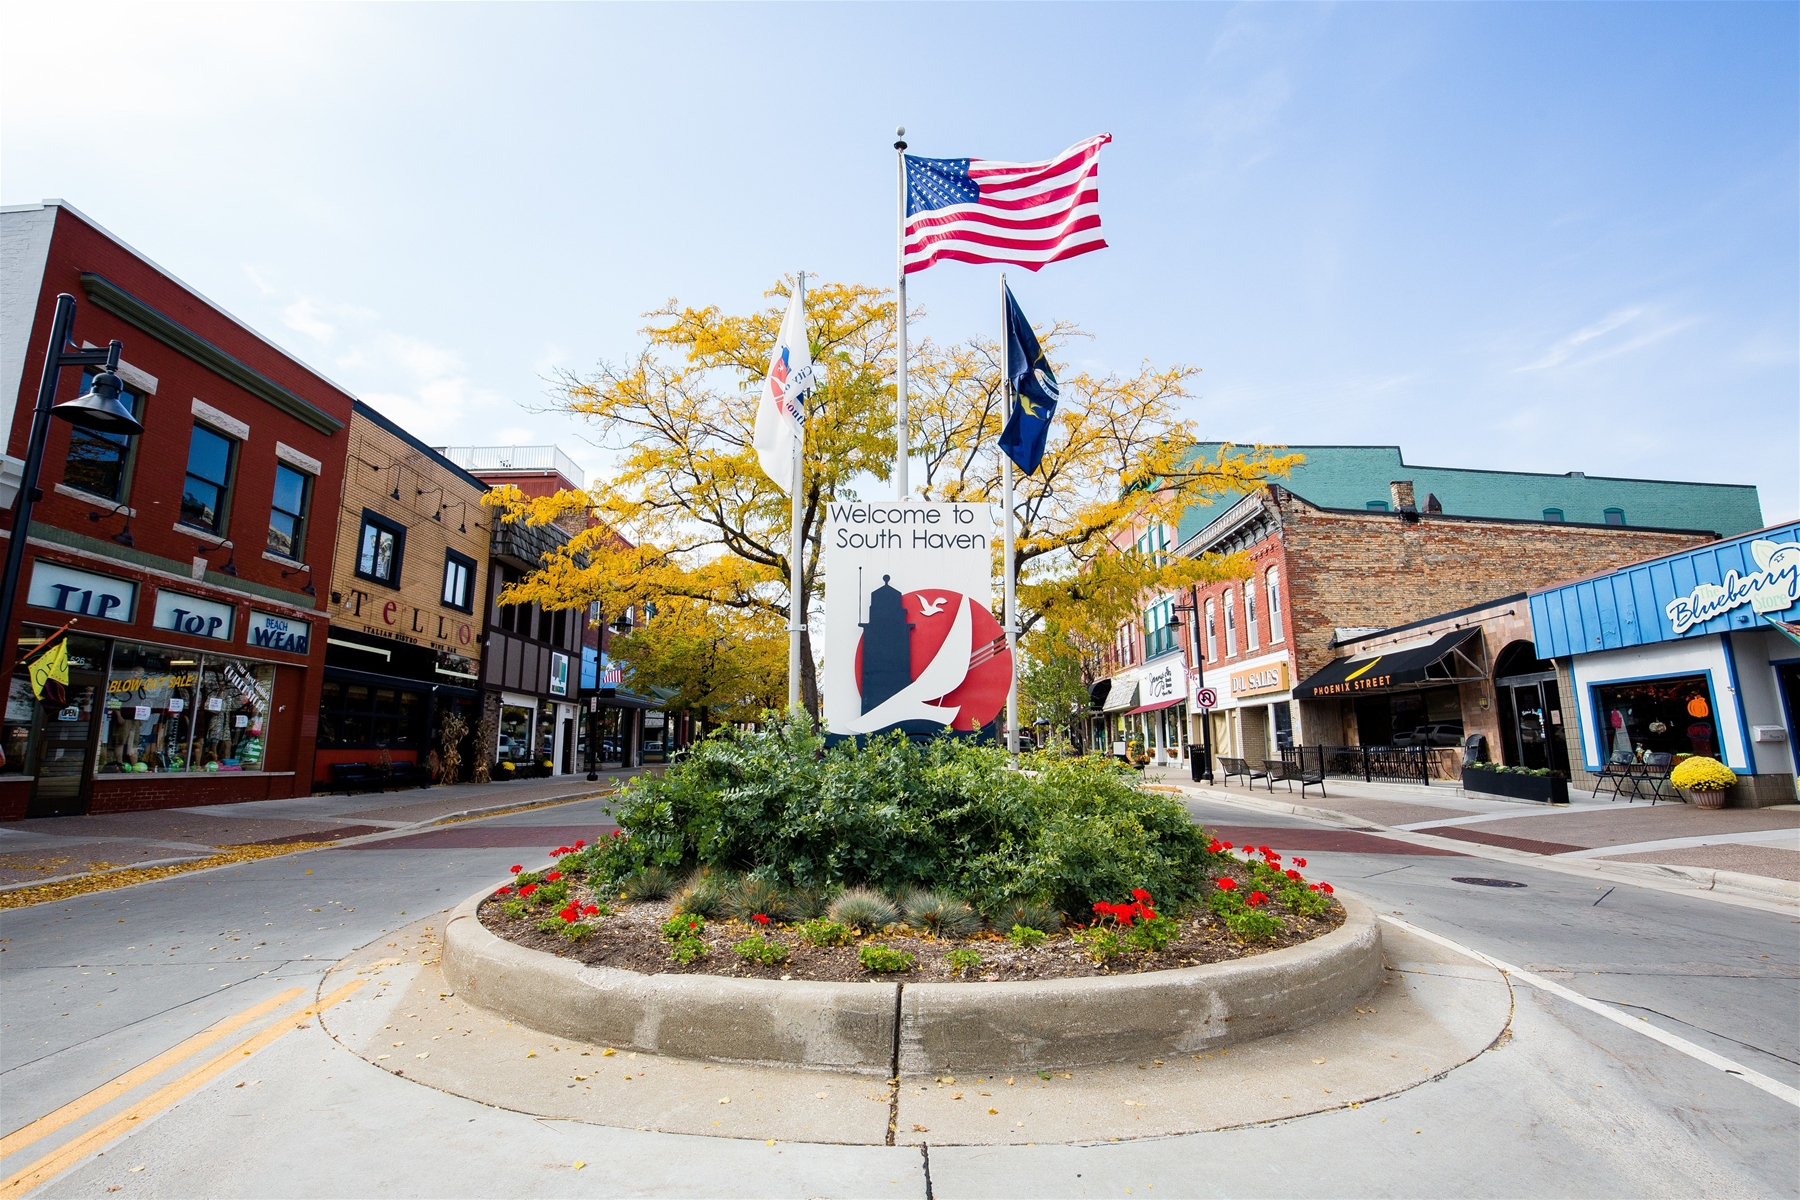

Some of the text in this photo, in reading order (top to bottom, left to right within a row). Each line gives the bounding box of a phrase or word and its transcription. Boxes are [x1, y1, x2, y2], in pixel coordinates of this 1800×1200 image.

[830, 504, 974, 524] Welcome to
[836, 528, 985, 549] South Haven
[1670, 564, 1800, 628] Blueberry
[1699, 585, 1720, 600] The
[1753, 593, 1789, 611] Store
[51, 583, 223, 638] TIP TOP
[265, 617, 289, 632] BEACH
[254, 626, 307, 653] WEAR
[363, 626, 393, 640] ITALIAN
[395, 633, 418, 645] BISTRO
[69, 656, 86, 666] 526
[108, 679, 143, 693] BLOW
[143, 676, 168, 691] OUT
[1248, 668, 1279, 690] SALES
[1313, 675, 1391, 697] PHOENIX STREET
[61, 708, 77, 718] OPEN
[1687, 725, 1711, 737] OPEN
